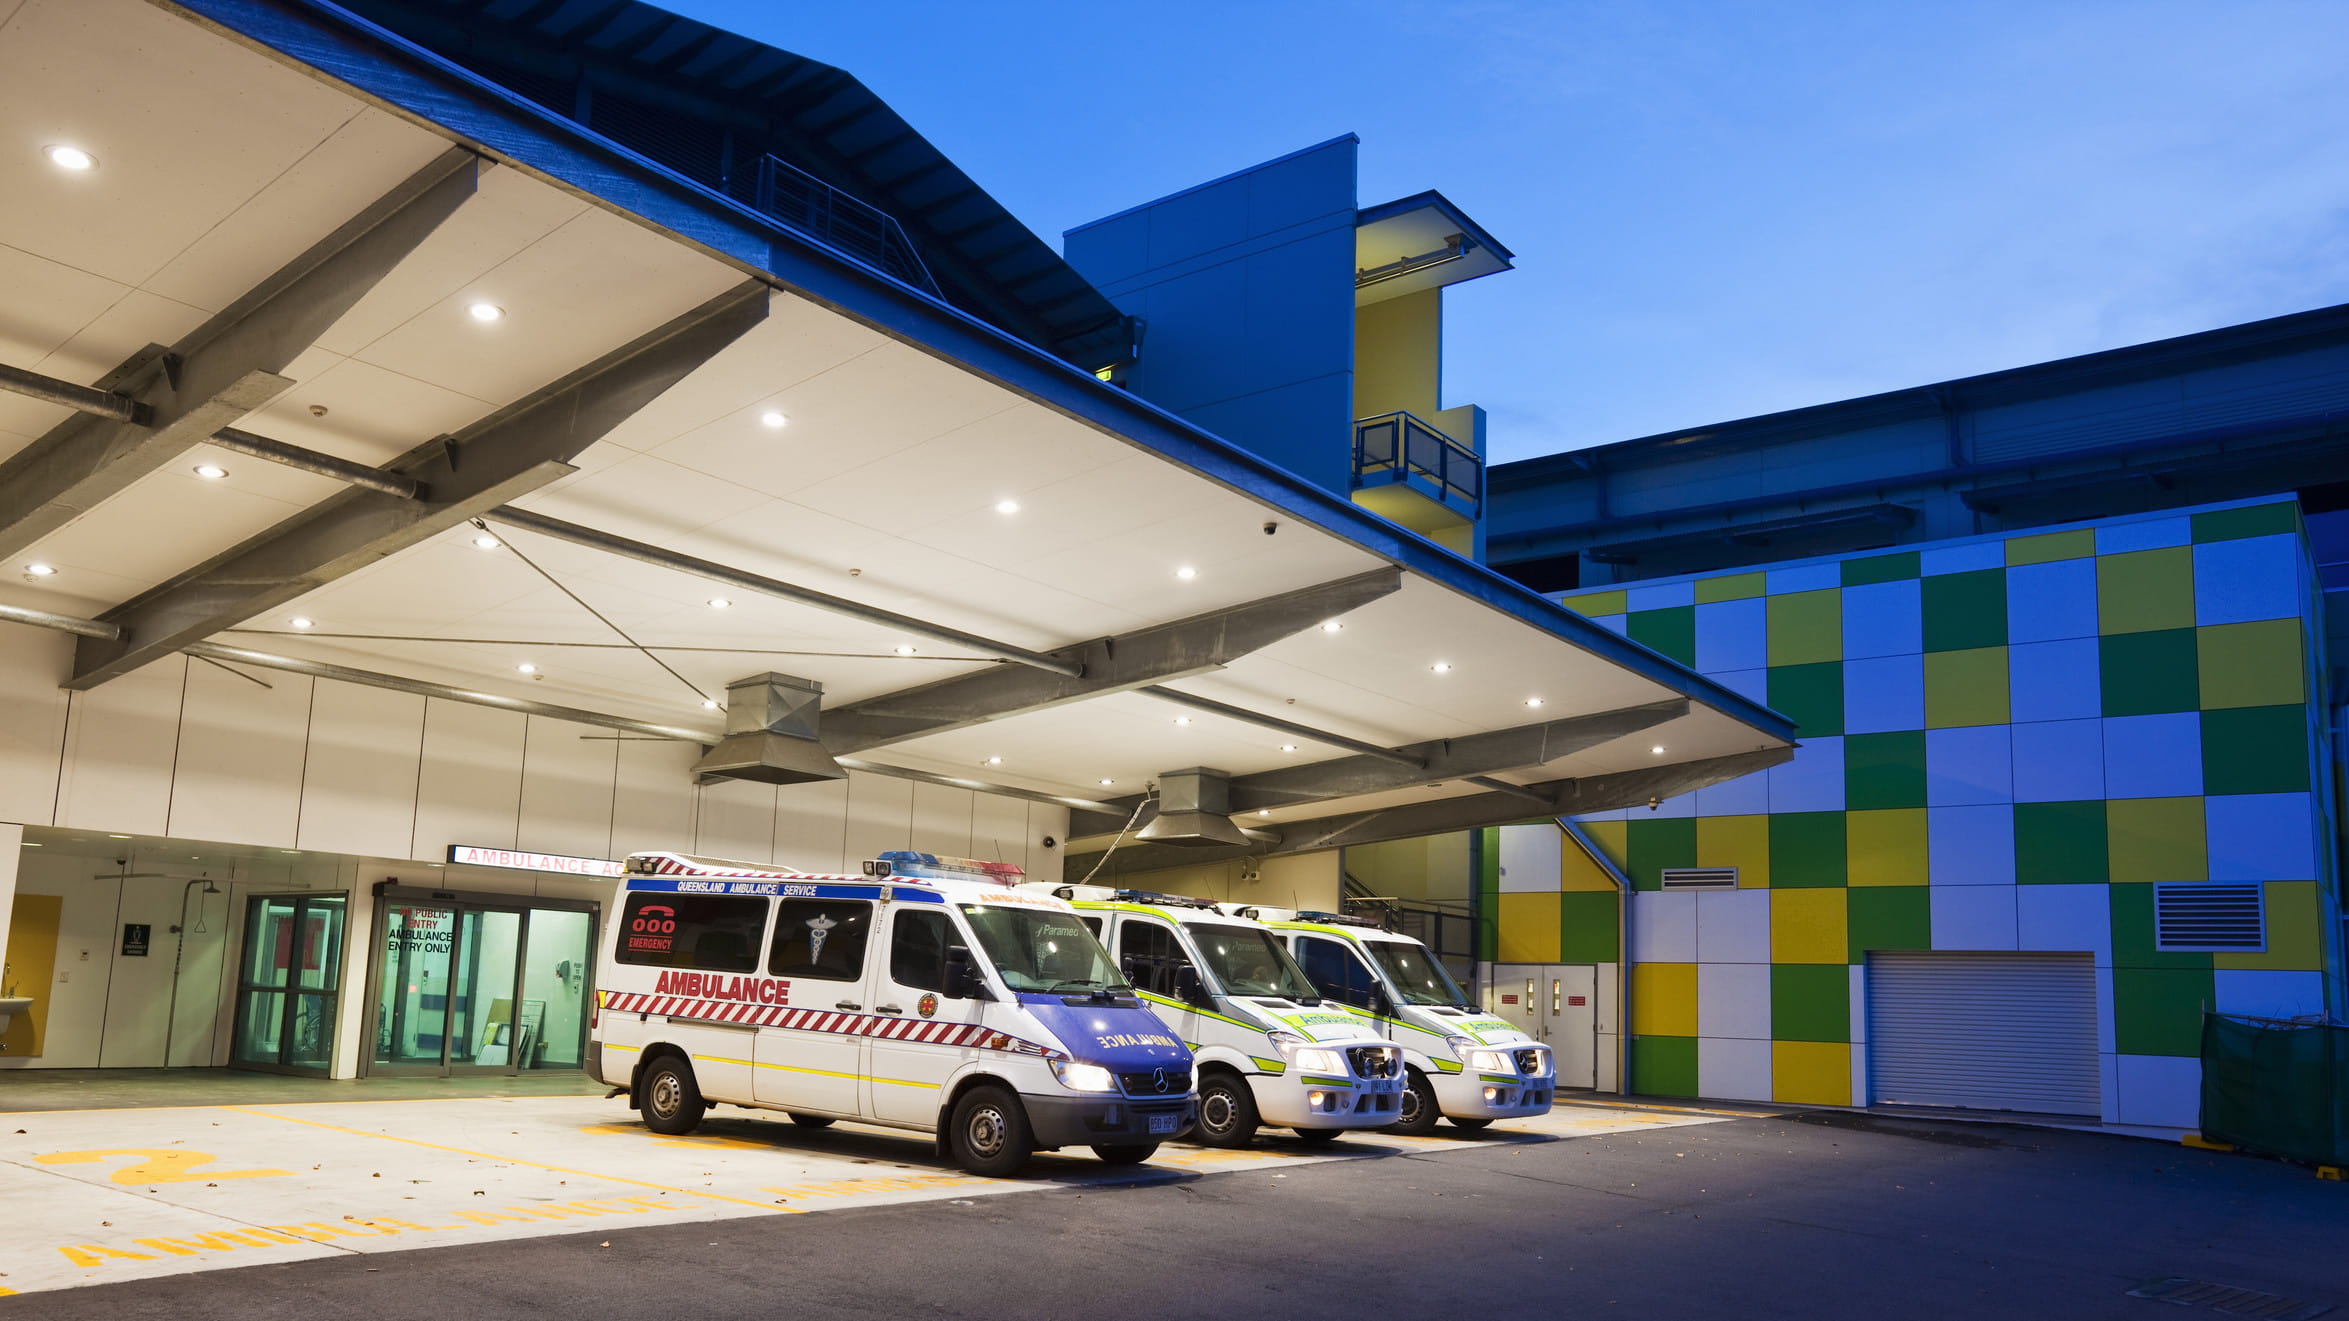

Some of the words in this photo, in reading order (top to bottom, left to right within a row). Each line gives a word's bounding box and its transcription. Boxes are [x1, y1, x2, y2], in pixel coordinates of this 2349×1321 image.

[467, 848, 591, 873] AMBULANCE
[677, 881, 725, 893] QUEENSLAND
[729, 883, 777, 895] AMBULANCE
[783, 885, 817, 896] SERVICE
[415, 908, 447, 919] PUBLIC
[407, 919, 438, 929] ENTRY
[389, 929, 453, 941] AMBULANCE
[389, 941, 422, 952] ENTRY
[425, 943, 450, 953] ONLY
[628, 937, 673, 950] EMERGENCY
[655, 970, 791, 1005] AMBULANCE
[32, 1148, 302, 1186] 2
[57, 1196, 702, 1268] AMBULANCE
